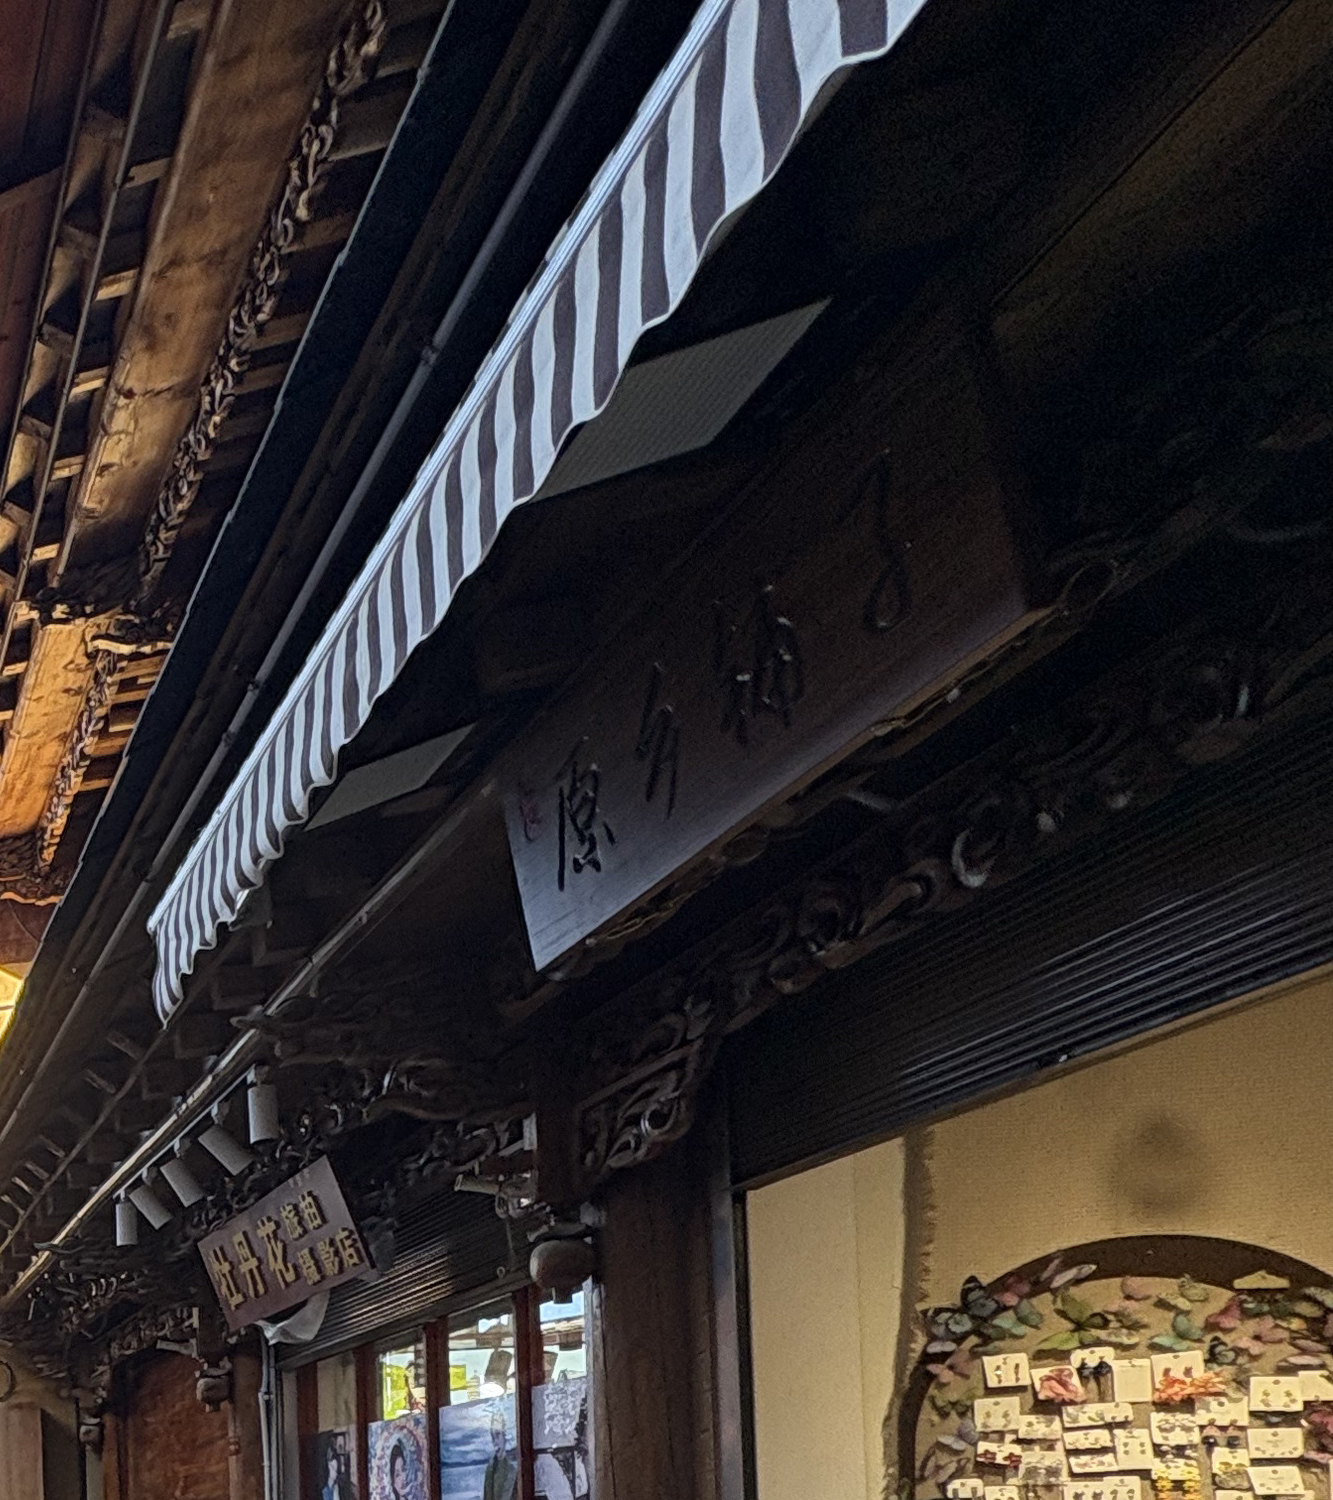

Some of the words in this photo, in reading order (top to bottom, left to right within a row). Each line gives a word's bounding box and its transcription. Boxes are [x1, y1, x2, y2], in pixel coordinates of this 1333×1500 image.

[213, 1216, 296, 1311] 牡丹花
[299, 1228, 361, 1285] 摄影店
